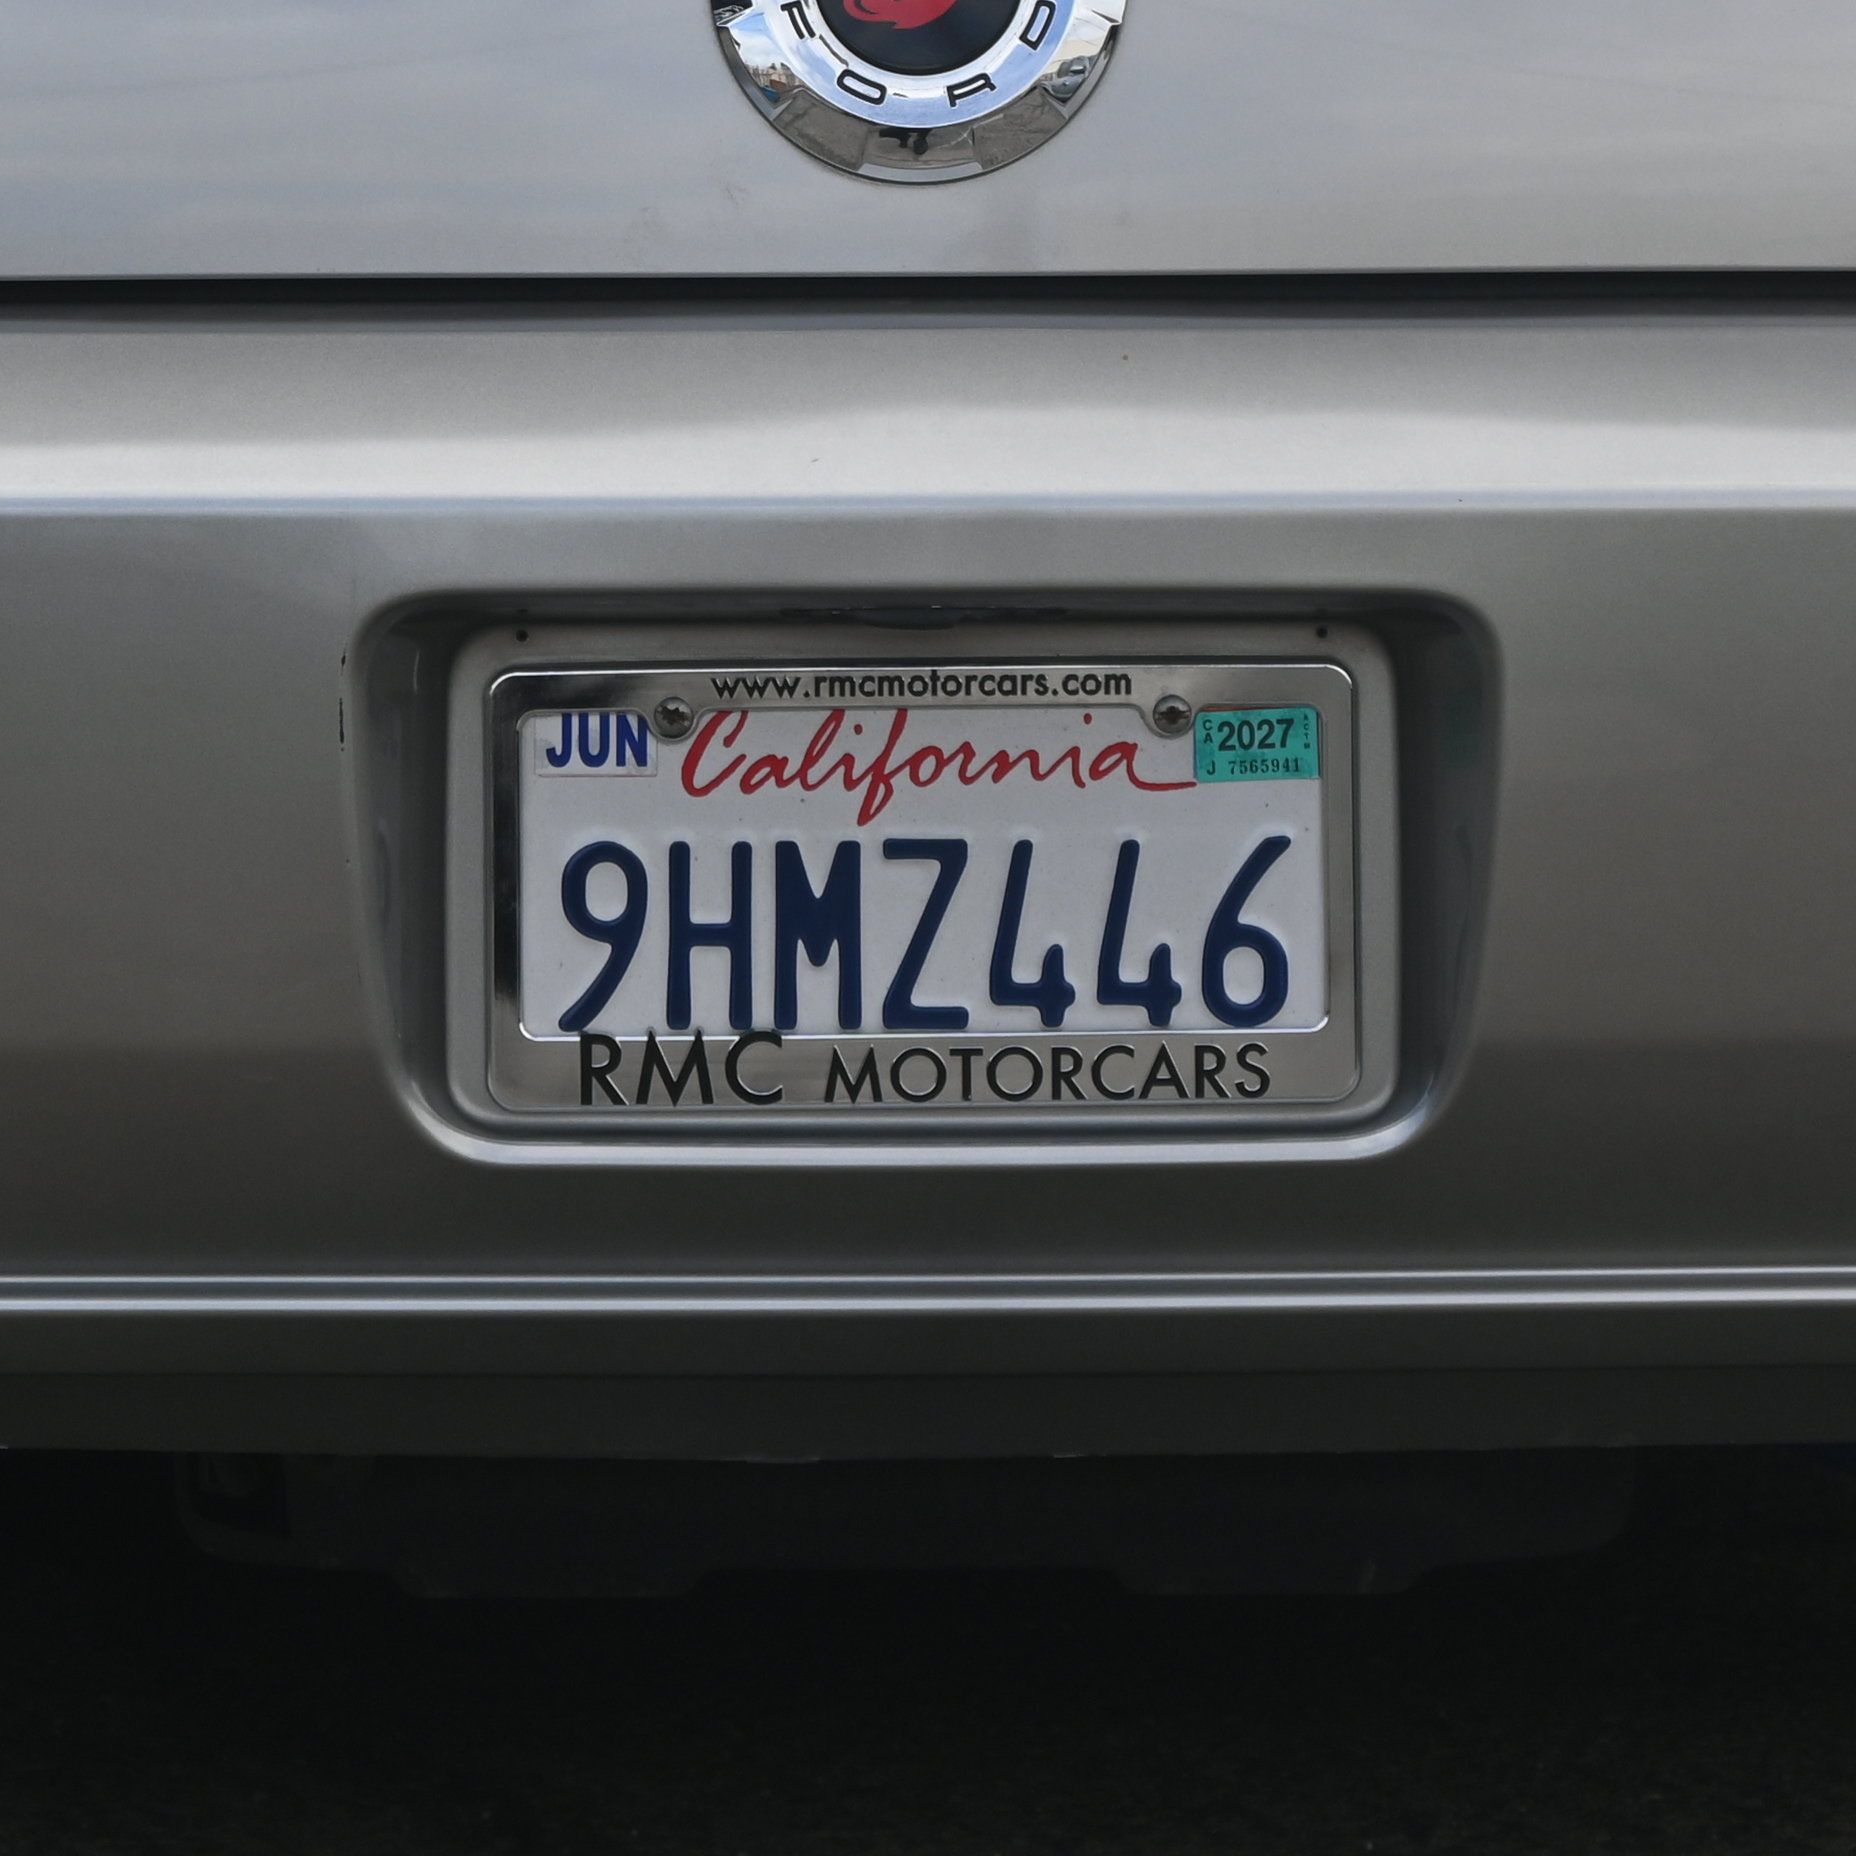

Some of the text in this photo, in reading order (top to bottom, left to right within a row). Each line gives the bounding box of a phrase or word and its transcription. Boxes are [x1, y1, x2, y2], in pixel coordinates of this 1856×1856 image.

[780, 0, 1057, 108] FORD
[711, 669, 1133, 700] www.rmcmotorcars.com
[545, 711, 649, 769] JUN
[681, 707, 1198, 826] California
[1217, 717, 1295, 752] 2027
[558, 835, 1292, 1032] 9HMZ446
[580, 1029, 1271, 1107] RMC MOTORCARS
